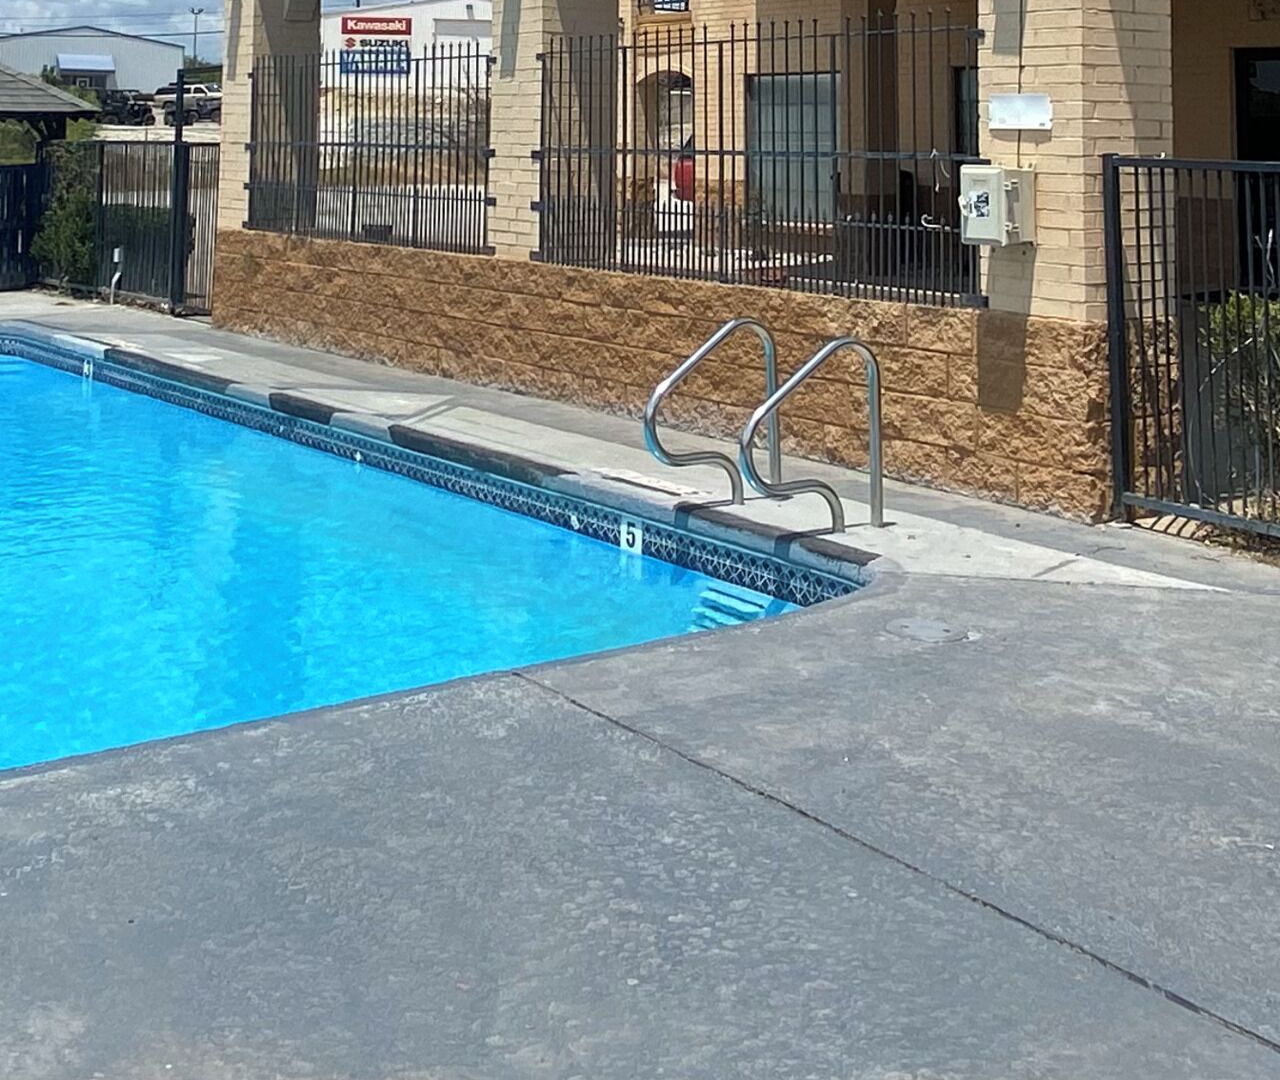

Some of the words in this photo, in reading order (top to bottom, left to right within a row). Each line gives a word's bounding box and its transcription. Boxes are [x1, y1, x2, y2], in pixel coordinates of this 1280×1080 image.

[347, 20, 407, 31] Kawasaki
[359, 39, 409, 48] SUZUKI
[625, 521, 636, 549] 5
